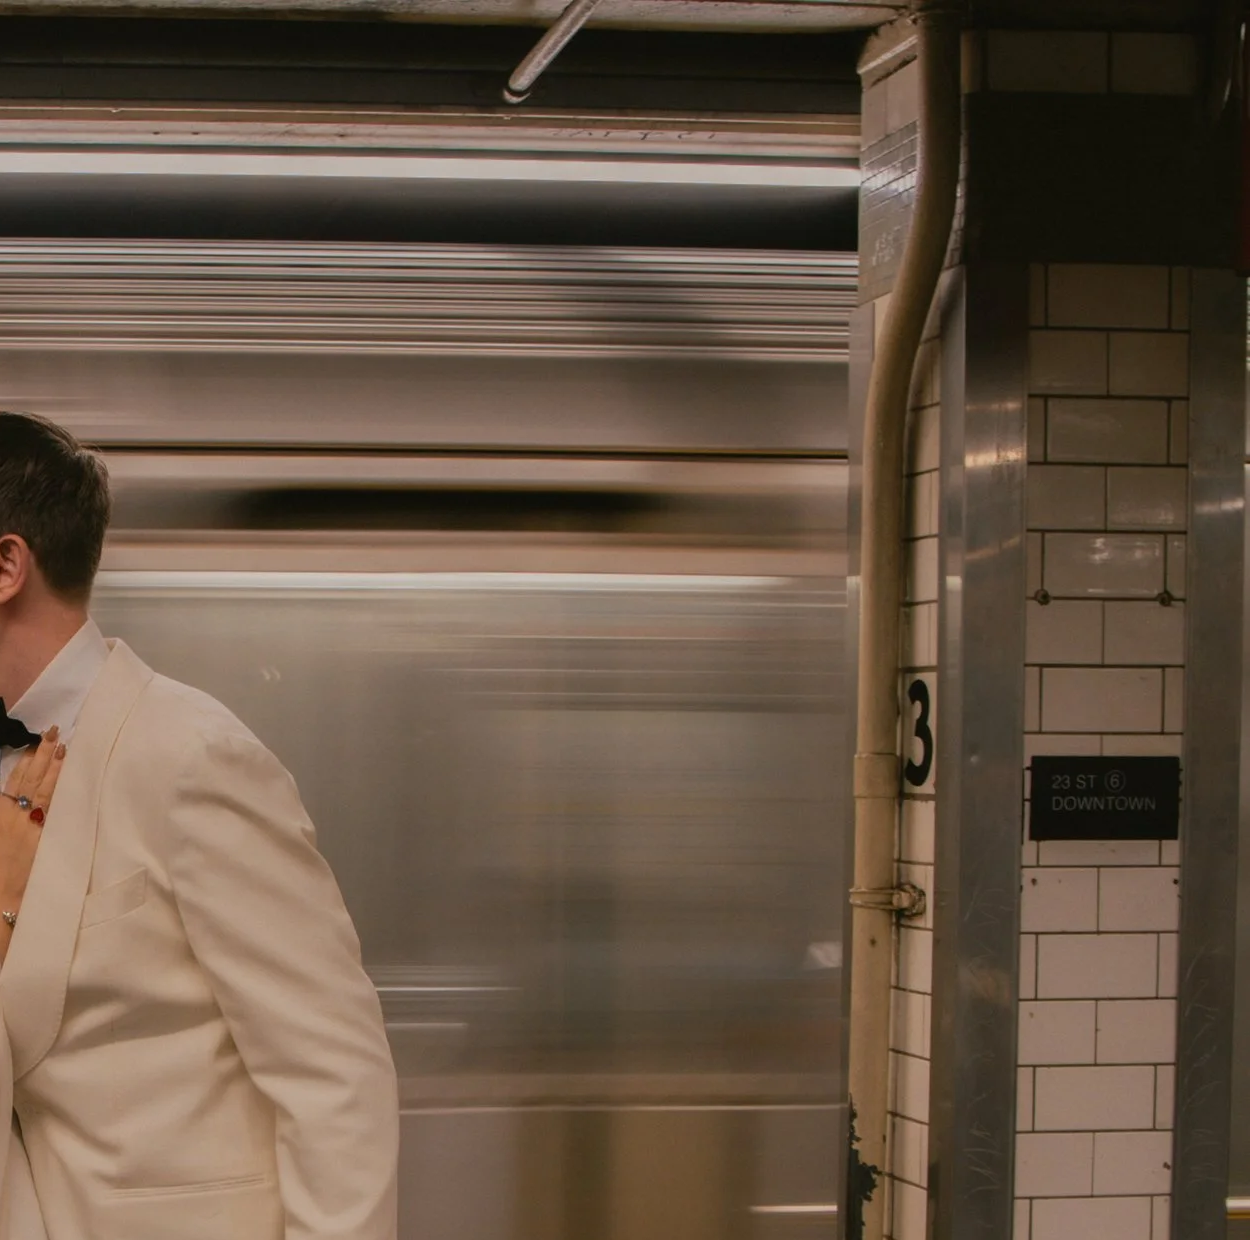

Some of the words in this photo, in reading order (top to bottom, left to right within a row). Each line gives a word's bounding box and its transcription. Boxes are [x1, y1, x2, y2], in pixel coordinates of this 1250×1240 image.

[904, 679, 933, 787] 3
[1052, 774, 1071, 789] 23
[1076, 774, 1097, 789] ST
[1052, 796, 1156, 811] DOWNTOWN
